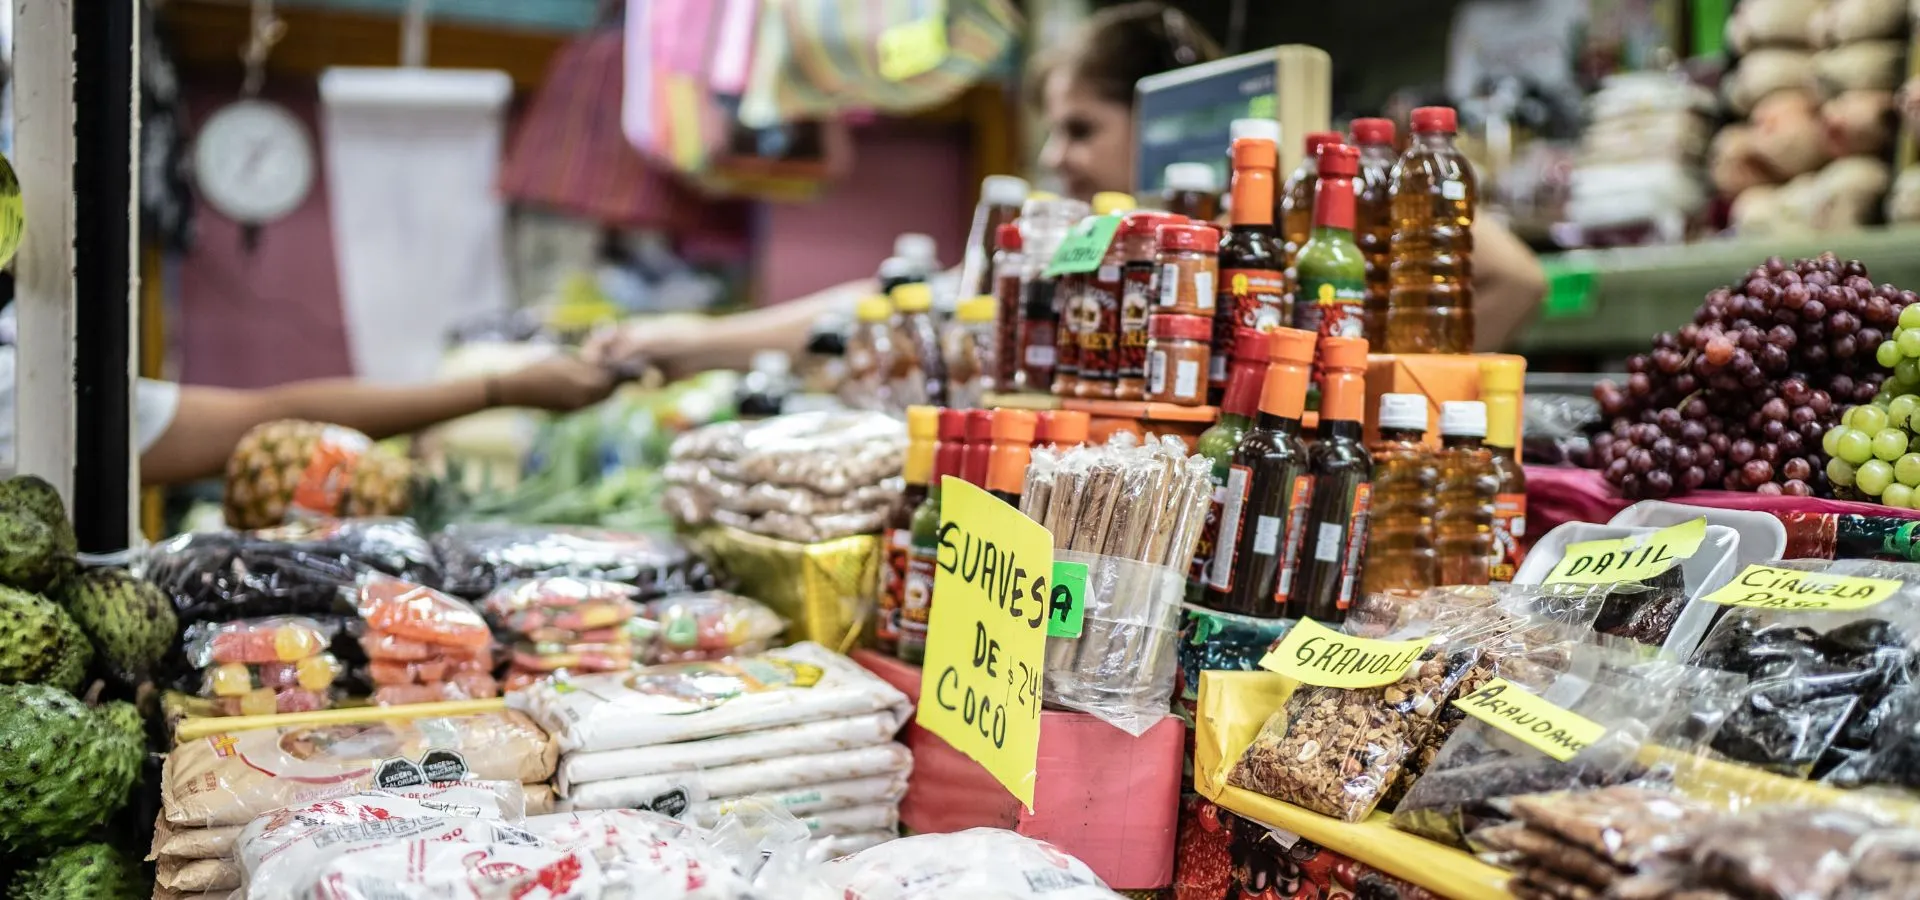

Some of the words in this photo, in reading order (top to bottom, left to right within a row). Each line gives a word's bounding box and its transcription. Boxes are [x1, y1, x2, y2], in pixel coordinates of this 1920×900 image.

[936, 522, 1046, 629] SUAVES
[1565, 544, 1674, 576] DATIL
[973, 621, 1001, 678] DE
[1296, 637, 1424, 675] GRANOLA
[937, 666, 1007, 749] COCO
[385, 770, 413, 783] EXCESO
